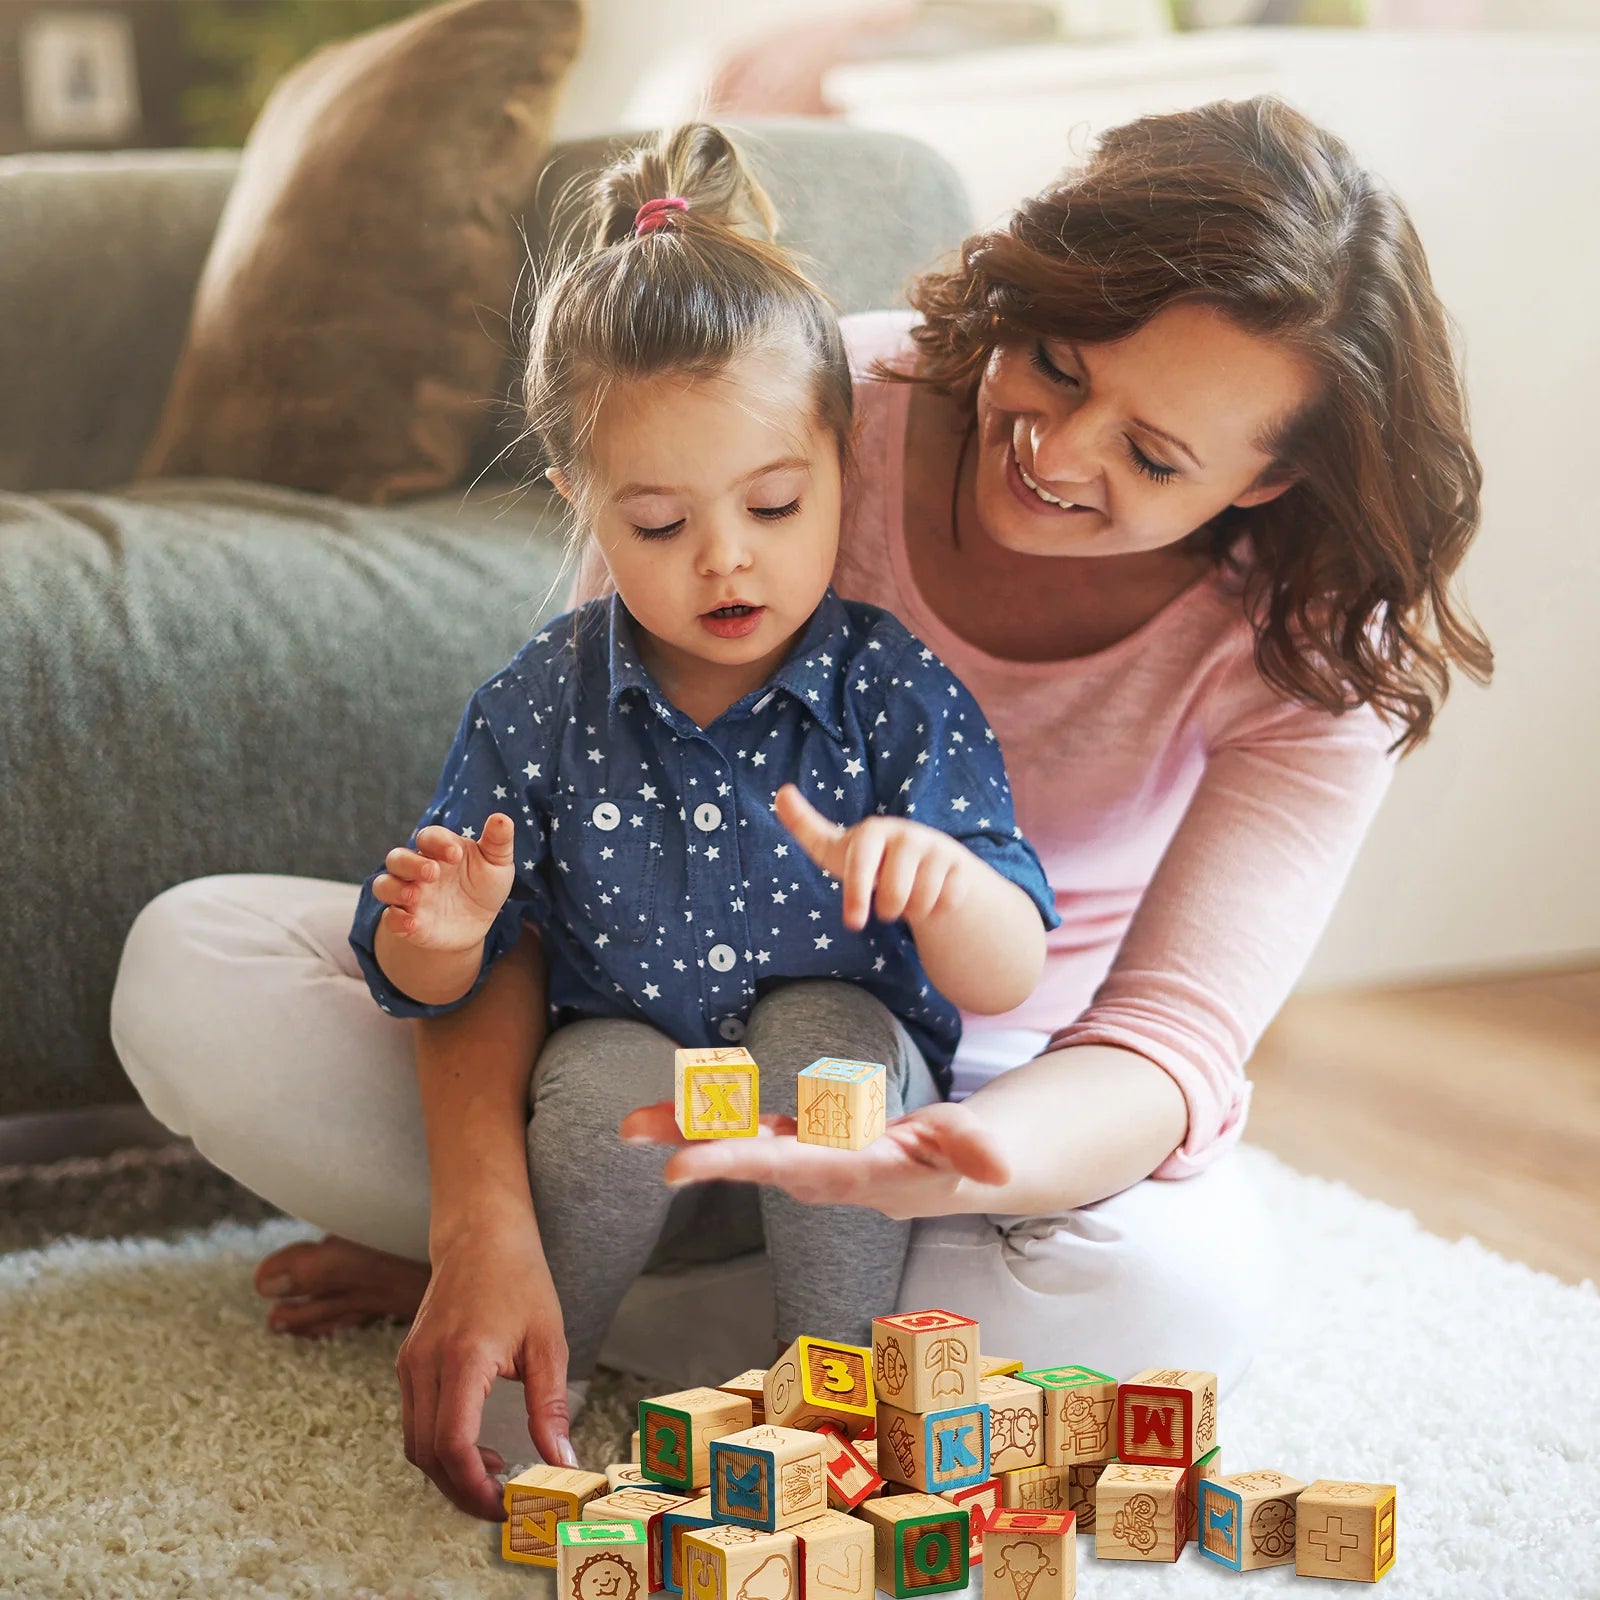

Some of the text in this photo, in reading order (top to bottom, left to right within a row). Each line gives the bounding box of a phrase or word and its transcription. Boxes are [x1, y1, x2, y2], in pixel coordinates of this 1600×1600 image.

[698, 1083, 743, 1122] X
[772, 1362, 796, 1415] 6
[821, 1359, 855, 1393] 3
[655, 1427, 679, 1467] 2
[938, 1425, 979, 1473] K
[726, 1463, 762, 1512] K
[969, 1503, 987, 1548] A
[1210, 1507, 1233, 1546] Y
